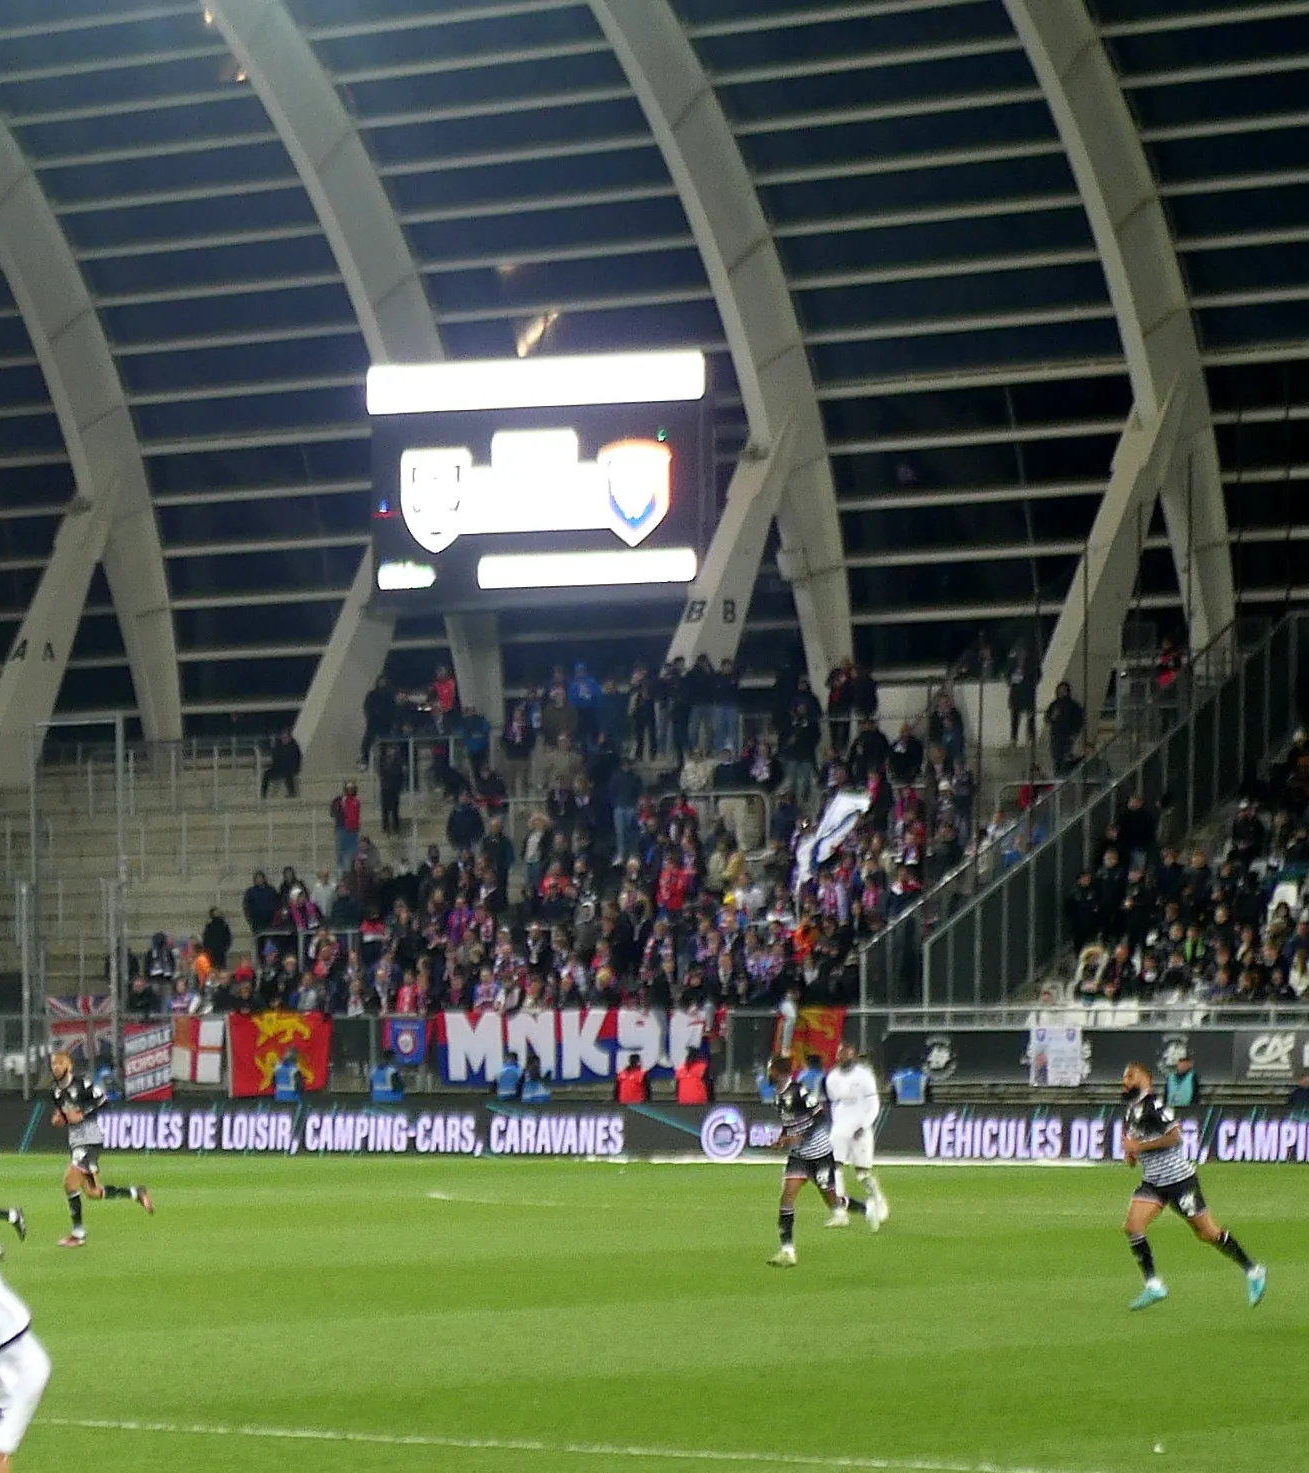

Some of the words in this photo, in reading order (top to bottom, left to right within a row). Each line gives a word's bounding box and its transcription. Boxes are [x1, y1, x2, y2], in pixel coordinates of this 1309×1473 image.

[97, 1113, 183, 1150] HICULES
[188, 1112, 217, 1149] DE
[221, 1112, 300, 1155] LOISIR,
[305, 1113, 482, 1158] CAMPING-CARS,
[489, 1115, 624, 1155] CARAVANES
[922, 1110, 1063, 1160] VÉHICULES
[1070, 1119, 1104, 1160] DE
